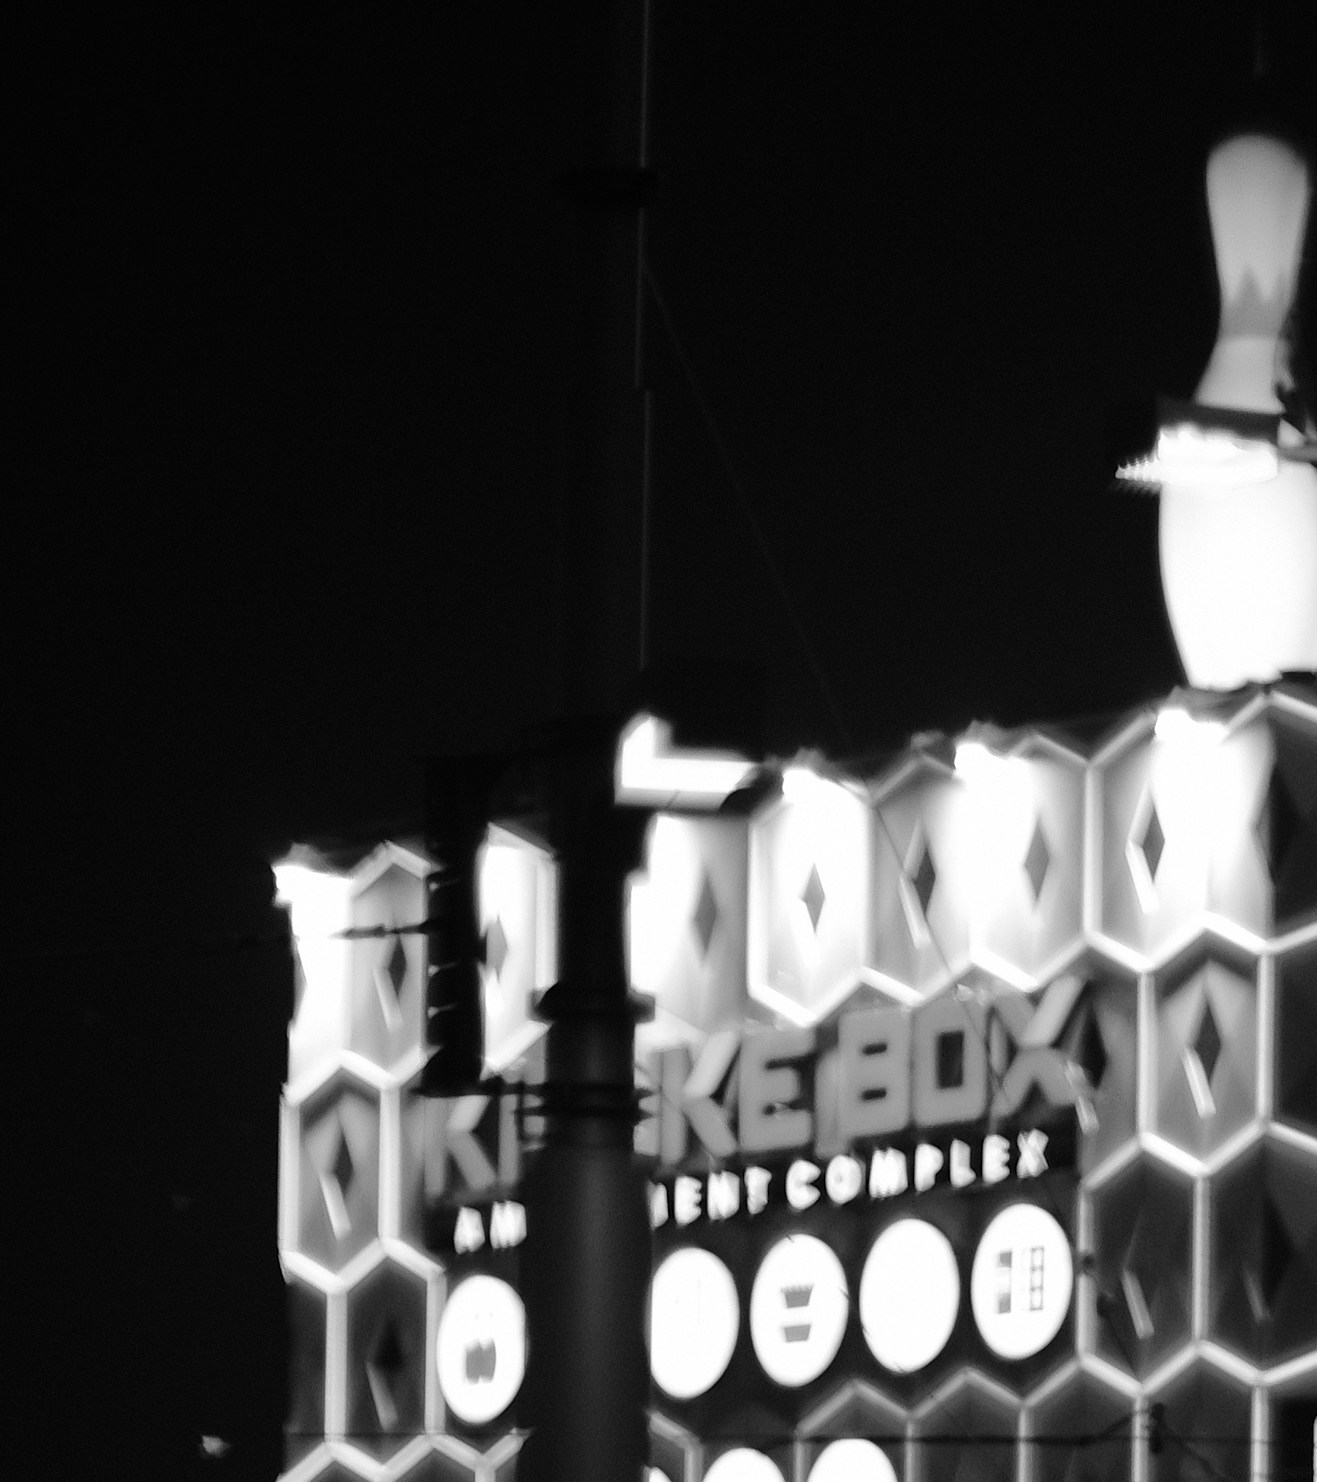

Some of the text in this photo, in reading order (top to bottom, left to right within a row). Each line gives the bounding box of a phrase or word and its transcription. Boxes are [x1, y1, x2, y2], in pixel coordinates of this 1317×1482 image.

[422, 972, 1082, 1200] KIKE BOX
[784, 1130, 1050, 1212] COMPLEX
